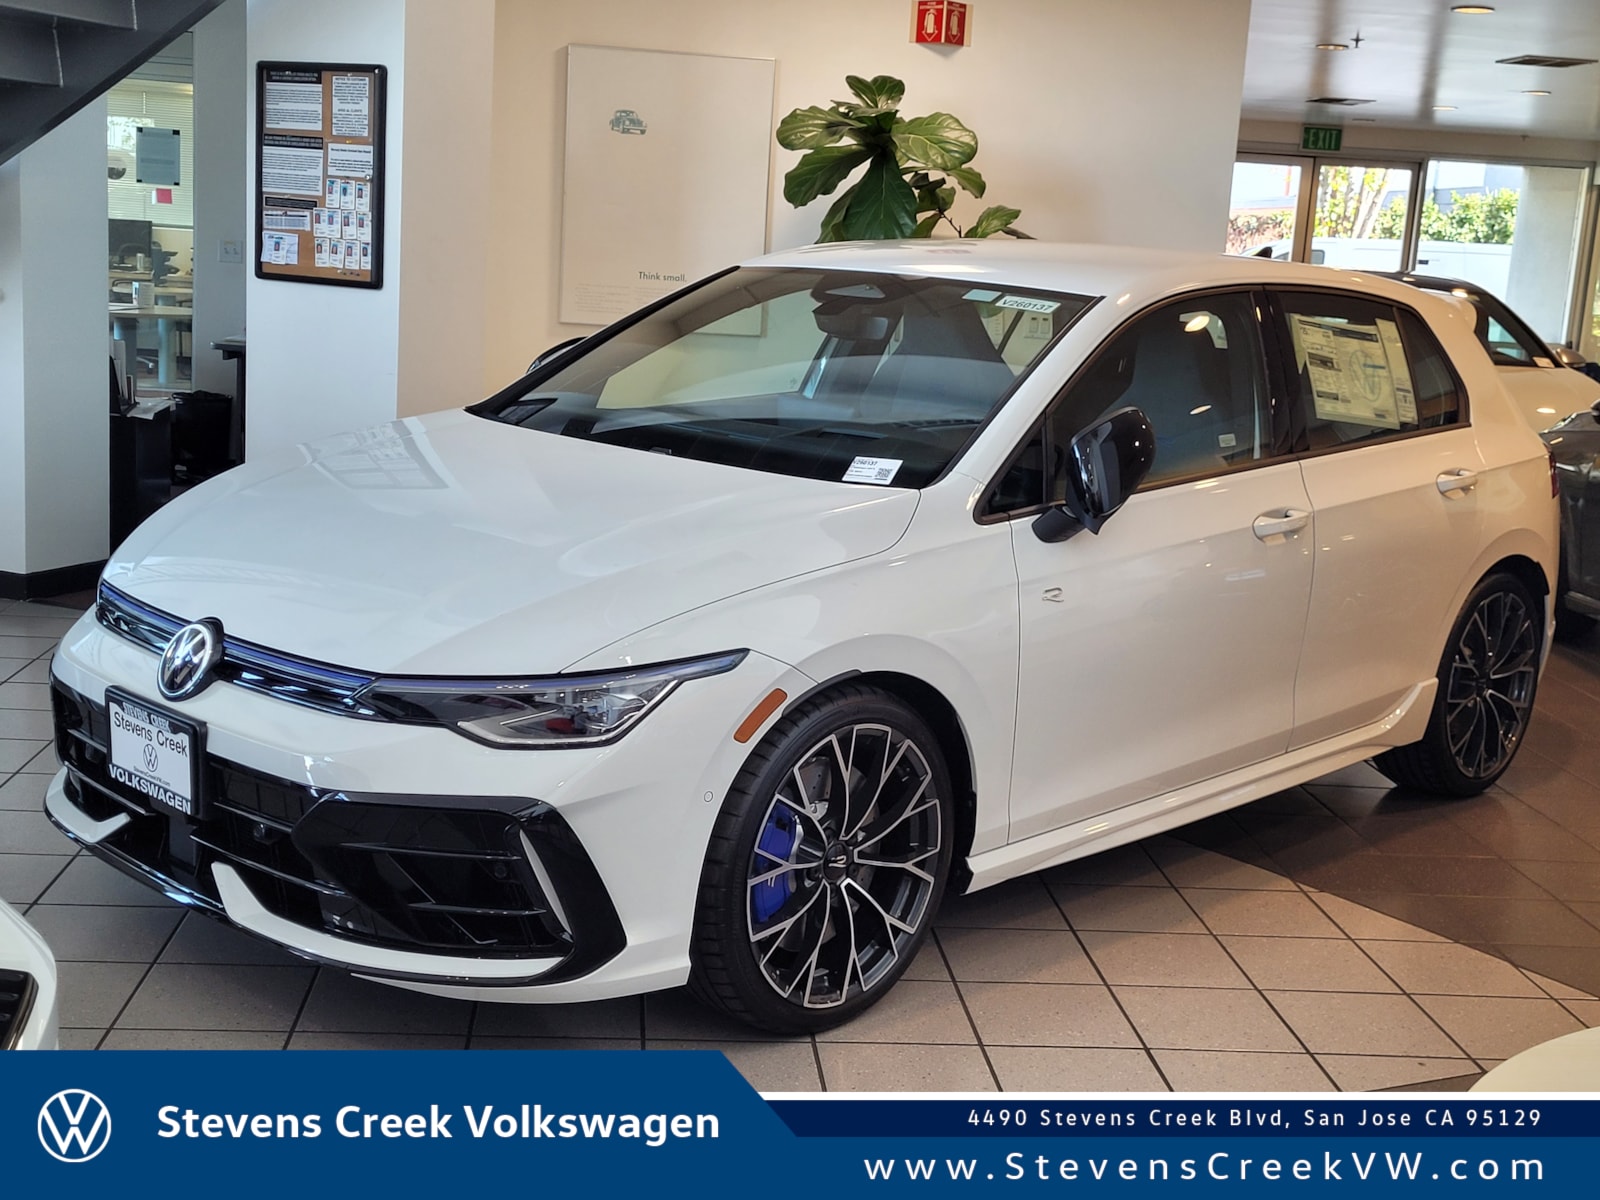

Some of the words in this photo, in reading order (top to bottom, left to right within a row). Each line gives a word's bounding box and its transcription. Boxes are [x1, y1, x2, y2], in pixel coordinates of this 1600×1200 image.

[1309, 128, 1339, 149] EXIT
[638, 271, 660, 281] Think
[663, 273, 687, 282] small.
[1002, 299, 1054, 311] V260137
[123, 702, 149, 724] STEVENS
[114, 711, 153, 742] Stevens
[156, 730, 188, 757] Creek
[109, 764, 191, 815] VOLKSWAGEN
